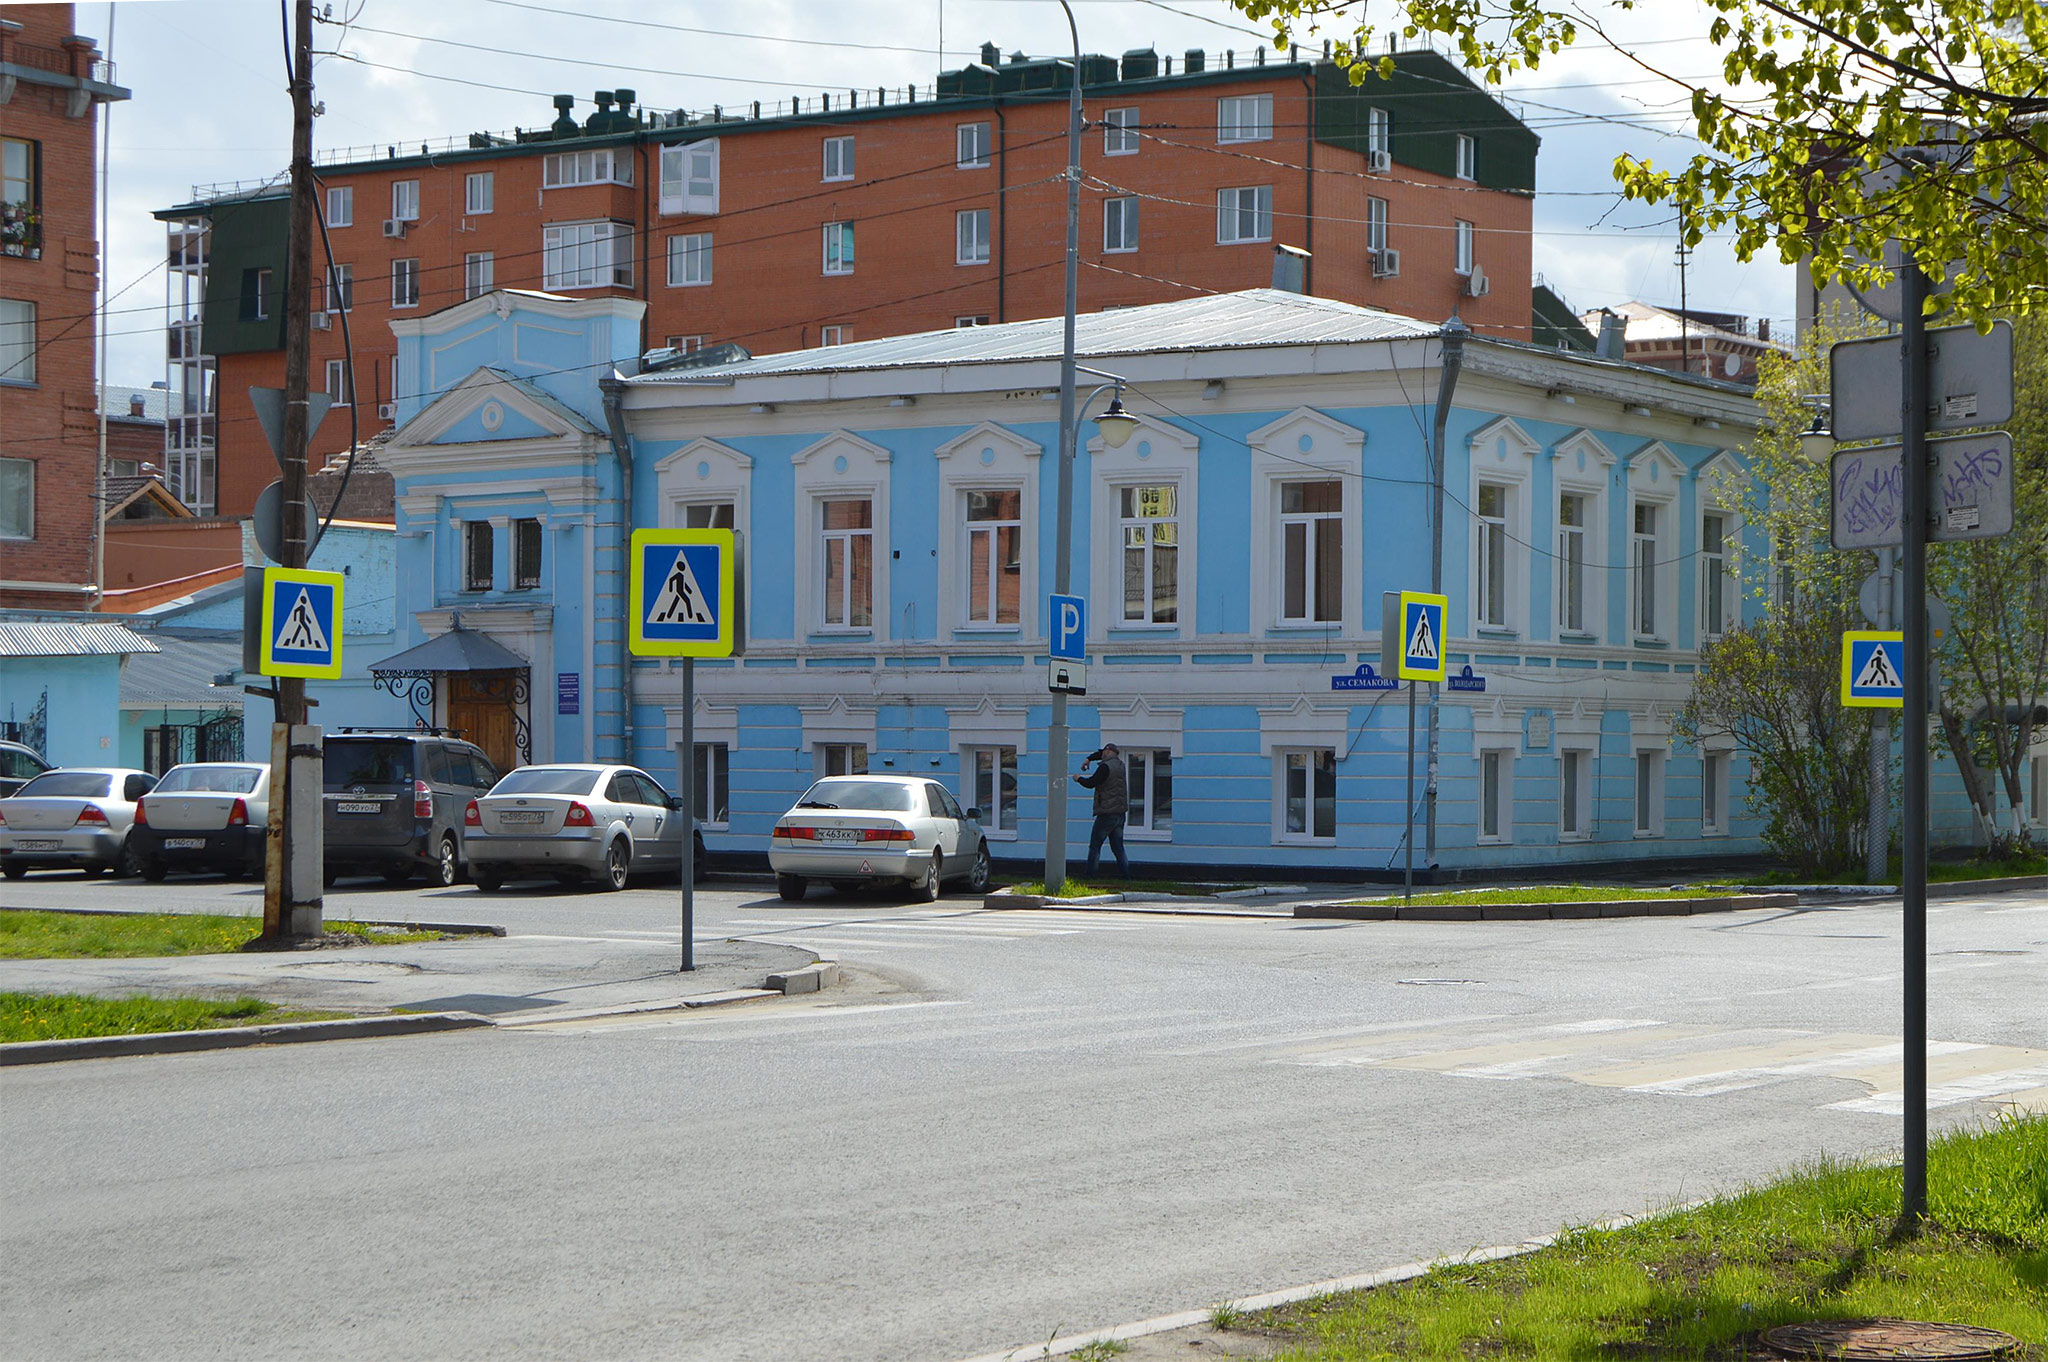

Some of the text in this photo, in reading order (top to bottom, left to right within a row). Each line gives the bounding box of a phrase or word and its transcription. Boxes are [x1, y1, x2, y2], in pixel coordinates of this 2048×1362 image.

[1060, 603, 1080, 651] P
[1361, 667, 1369, 675] 11
[1335, 678, 1394, 689] ул. СЕМАКОВА
